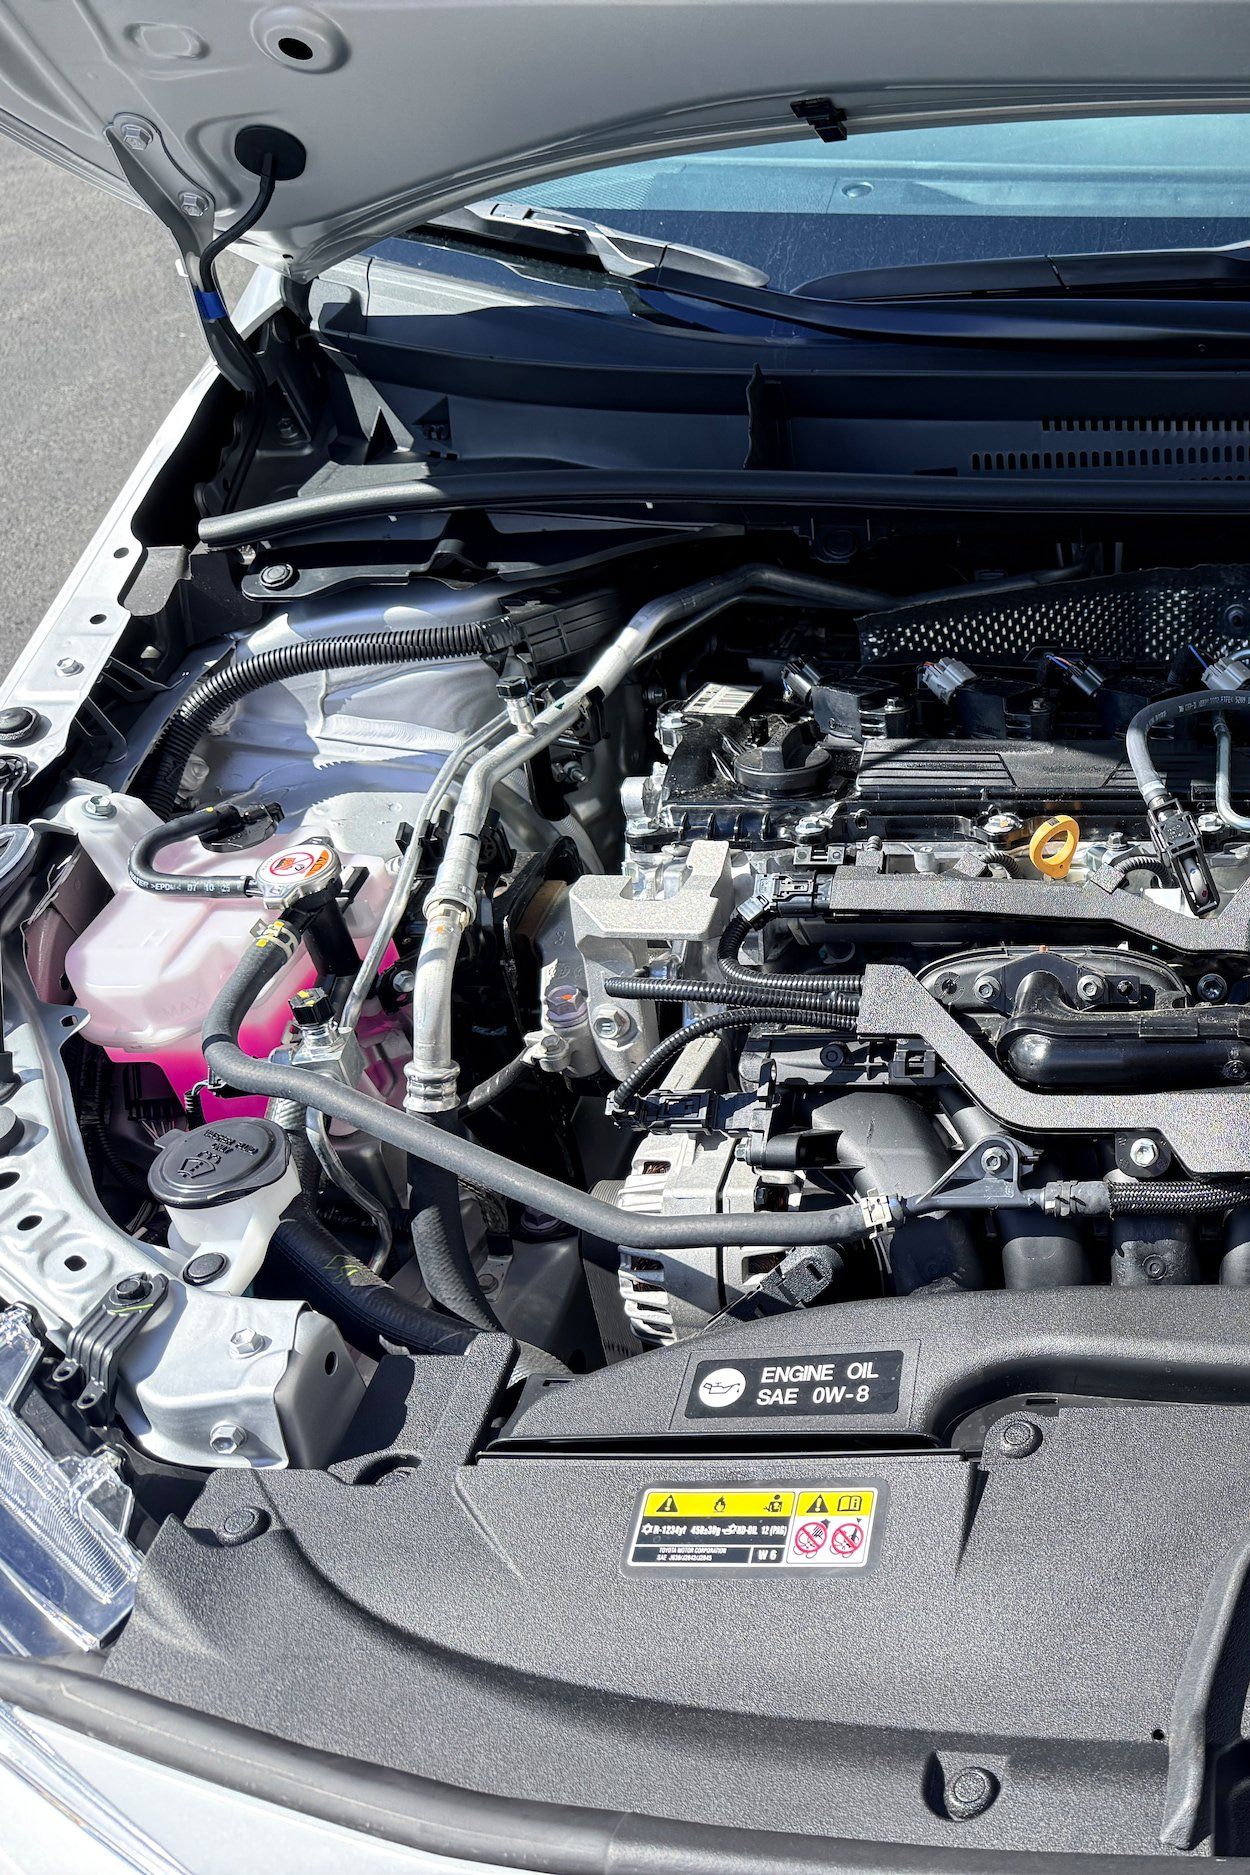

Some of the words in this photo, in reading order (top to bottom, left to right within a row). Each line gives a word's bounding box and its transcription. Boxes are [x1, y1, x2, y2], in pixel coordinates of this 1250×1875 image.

[760, 1364, 835, 1383] ENGINE
[846, 1362, 879, 1379] OIL
[756, 1388, 800, 1406] SAE
[812, 1385, 870, 1404] 0W-8
[653, 1525, 687, 1537] R-1234yf
[758, 1551, 770, 1560] W
[770, 1550, 777, 1560] 6
